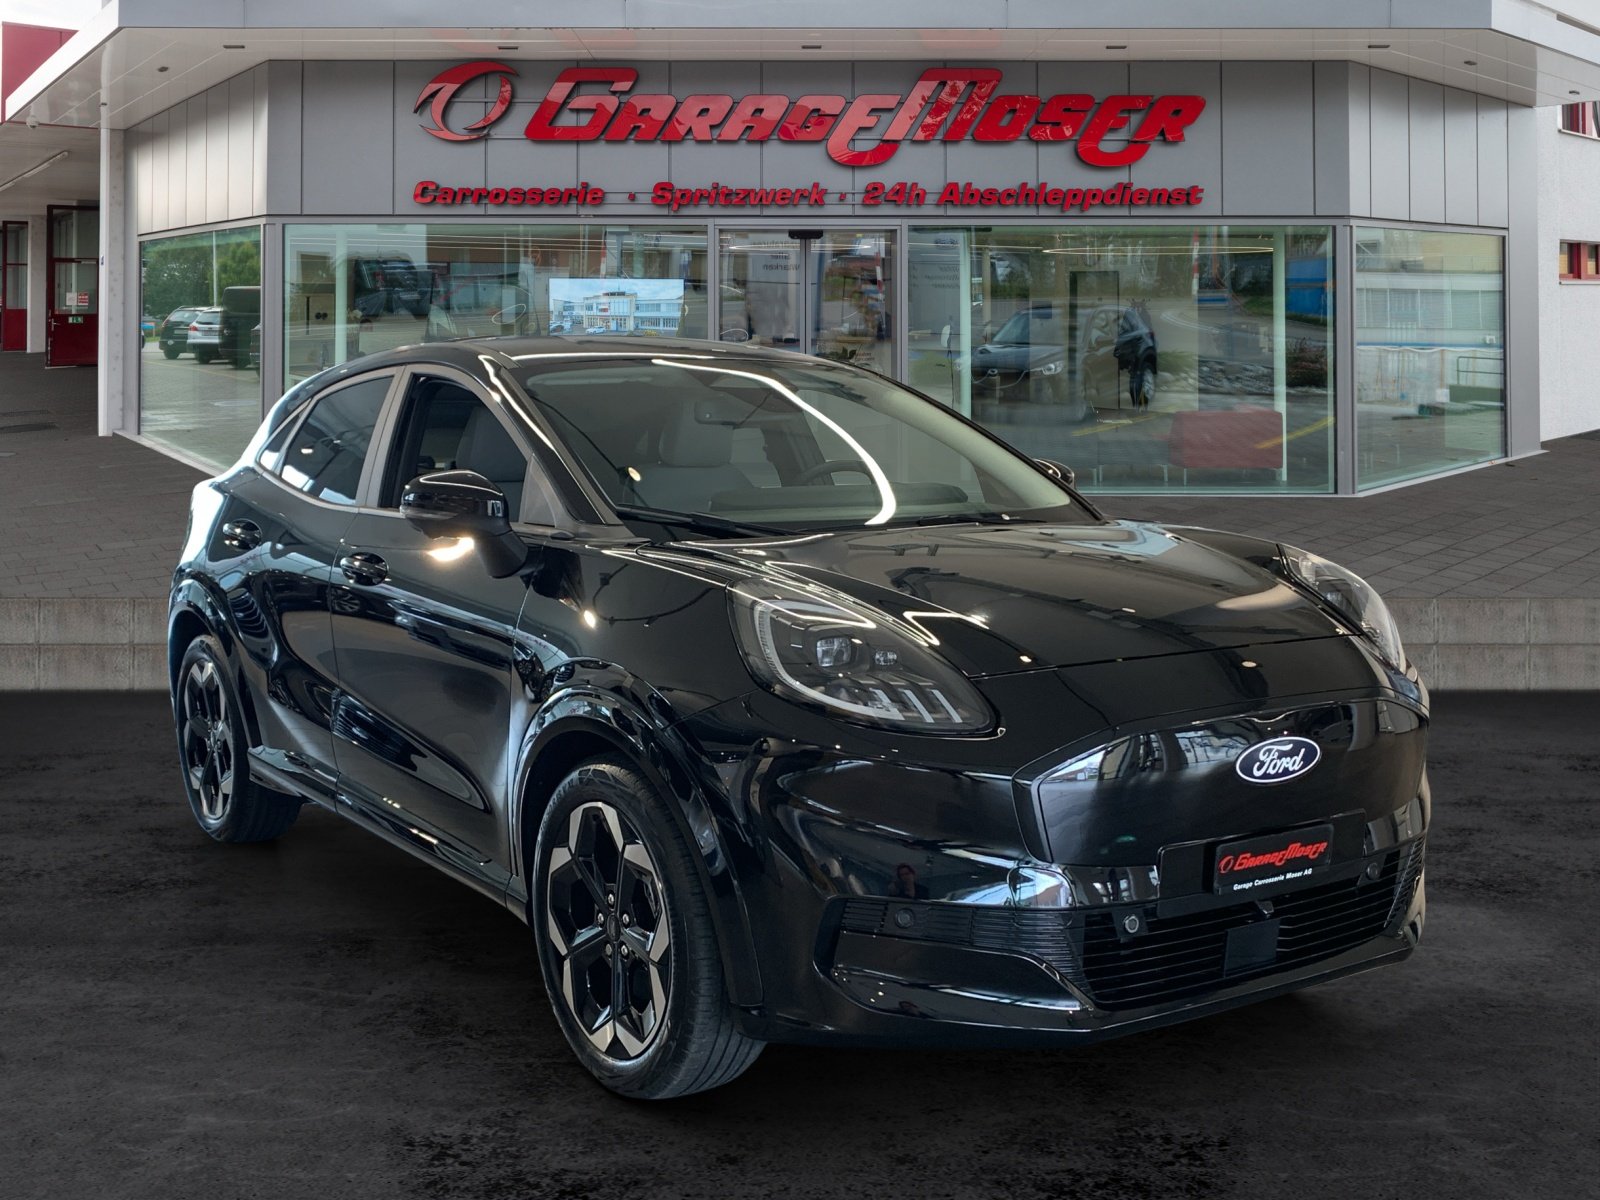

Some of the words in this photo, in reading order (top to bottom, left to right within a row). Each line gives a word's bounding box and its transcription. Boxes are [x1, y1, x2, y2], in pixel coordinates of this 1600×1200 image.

[413, 181, 604, 205] Carrosserie
[651, 182, 826, 211] Spritzwerk
[863, 182, 926, 205] 24h
[937, 182, 1204, 211] Abschleppdienst
[1252, 743, 1306, 777] Ford
[1233, 881, 1253, 891] Garage
[1254, 874, 1285, 887] Carrosserie
[1286, 871, 1303, 880] Moser
[1303, 867, 1313, 876] AG
